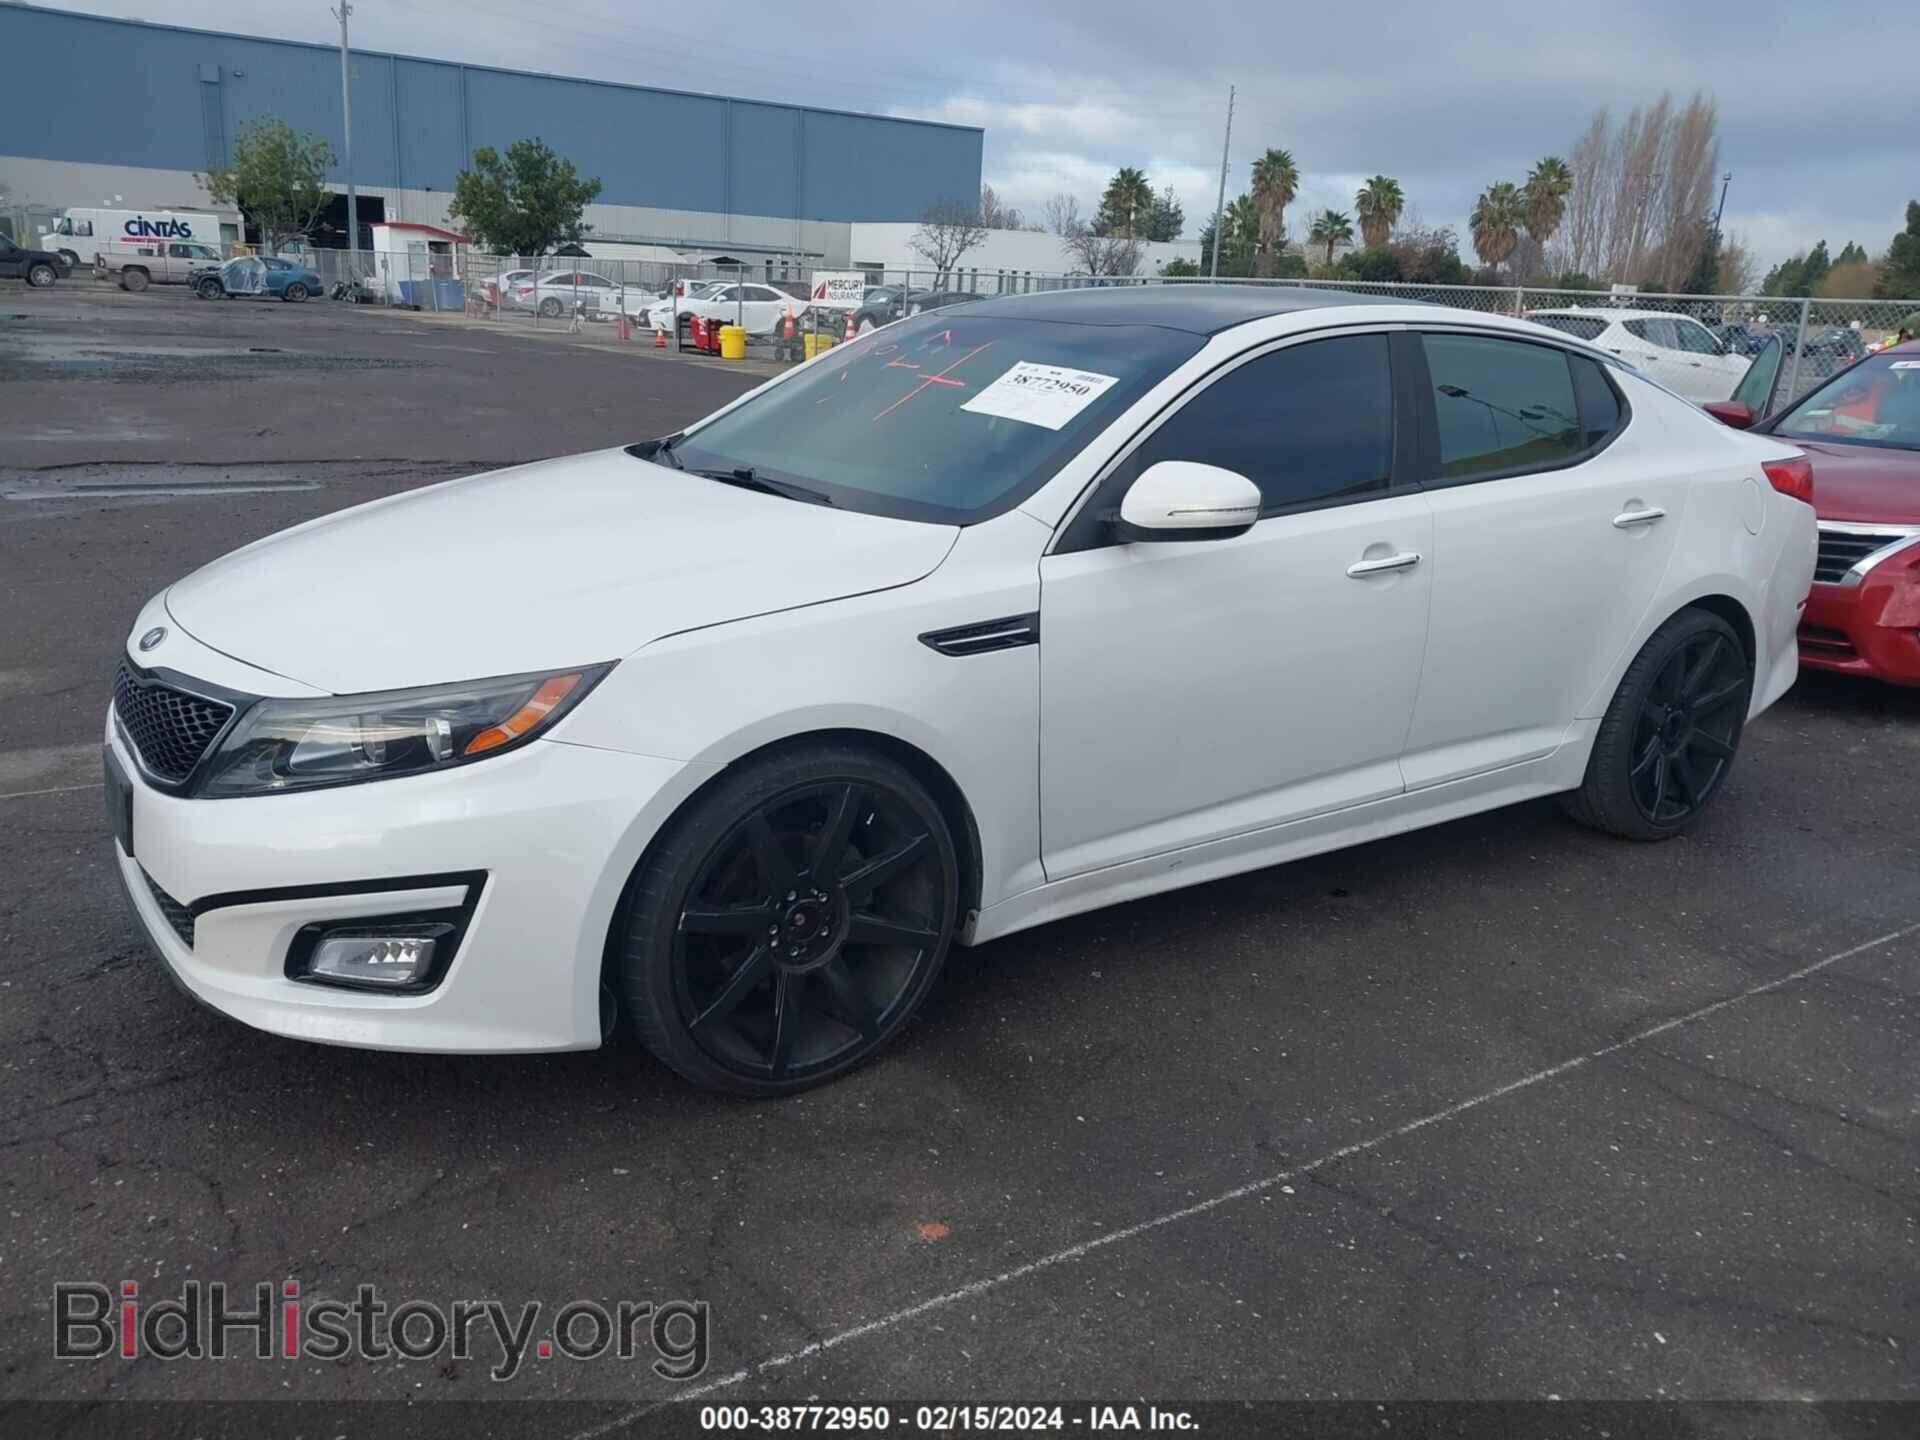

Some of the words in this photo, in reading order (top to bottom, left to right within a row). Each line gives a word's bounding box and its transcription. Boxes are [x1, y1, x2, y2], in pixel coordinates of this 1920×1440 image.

[827, 279, 864, 290] MERCURY
[827, 290, 864, 301] INSURANCE
[1007, 373, 1091, 396] 38772950
